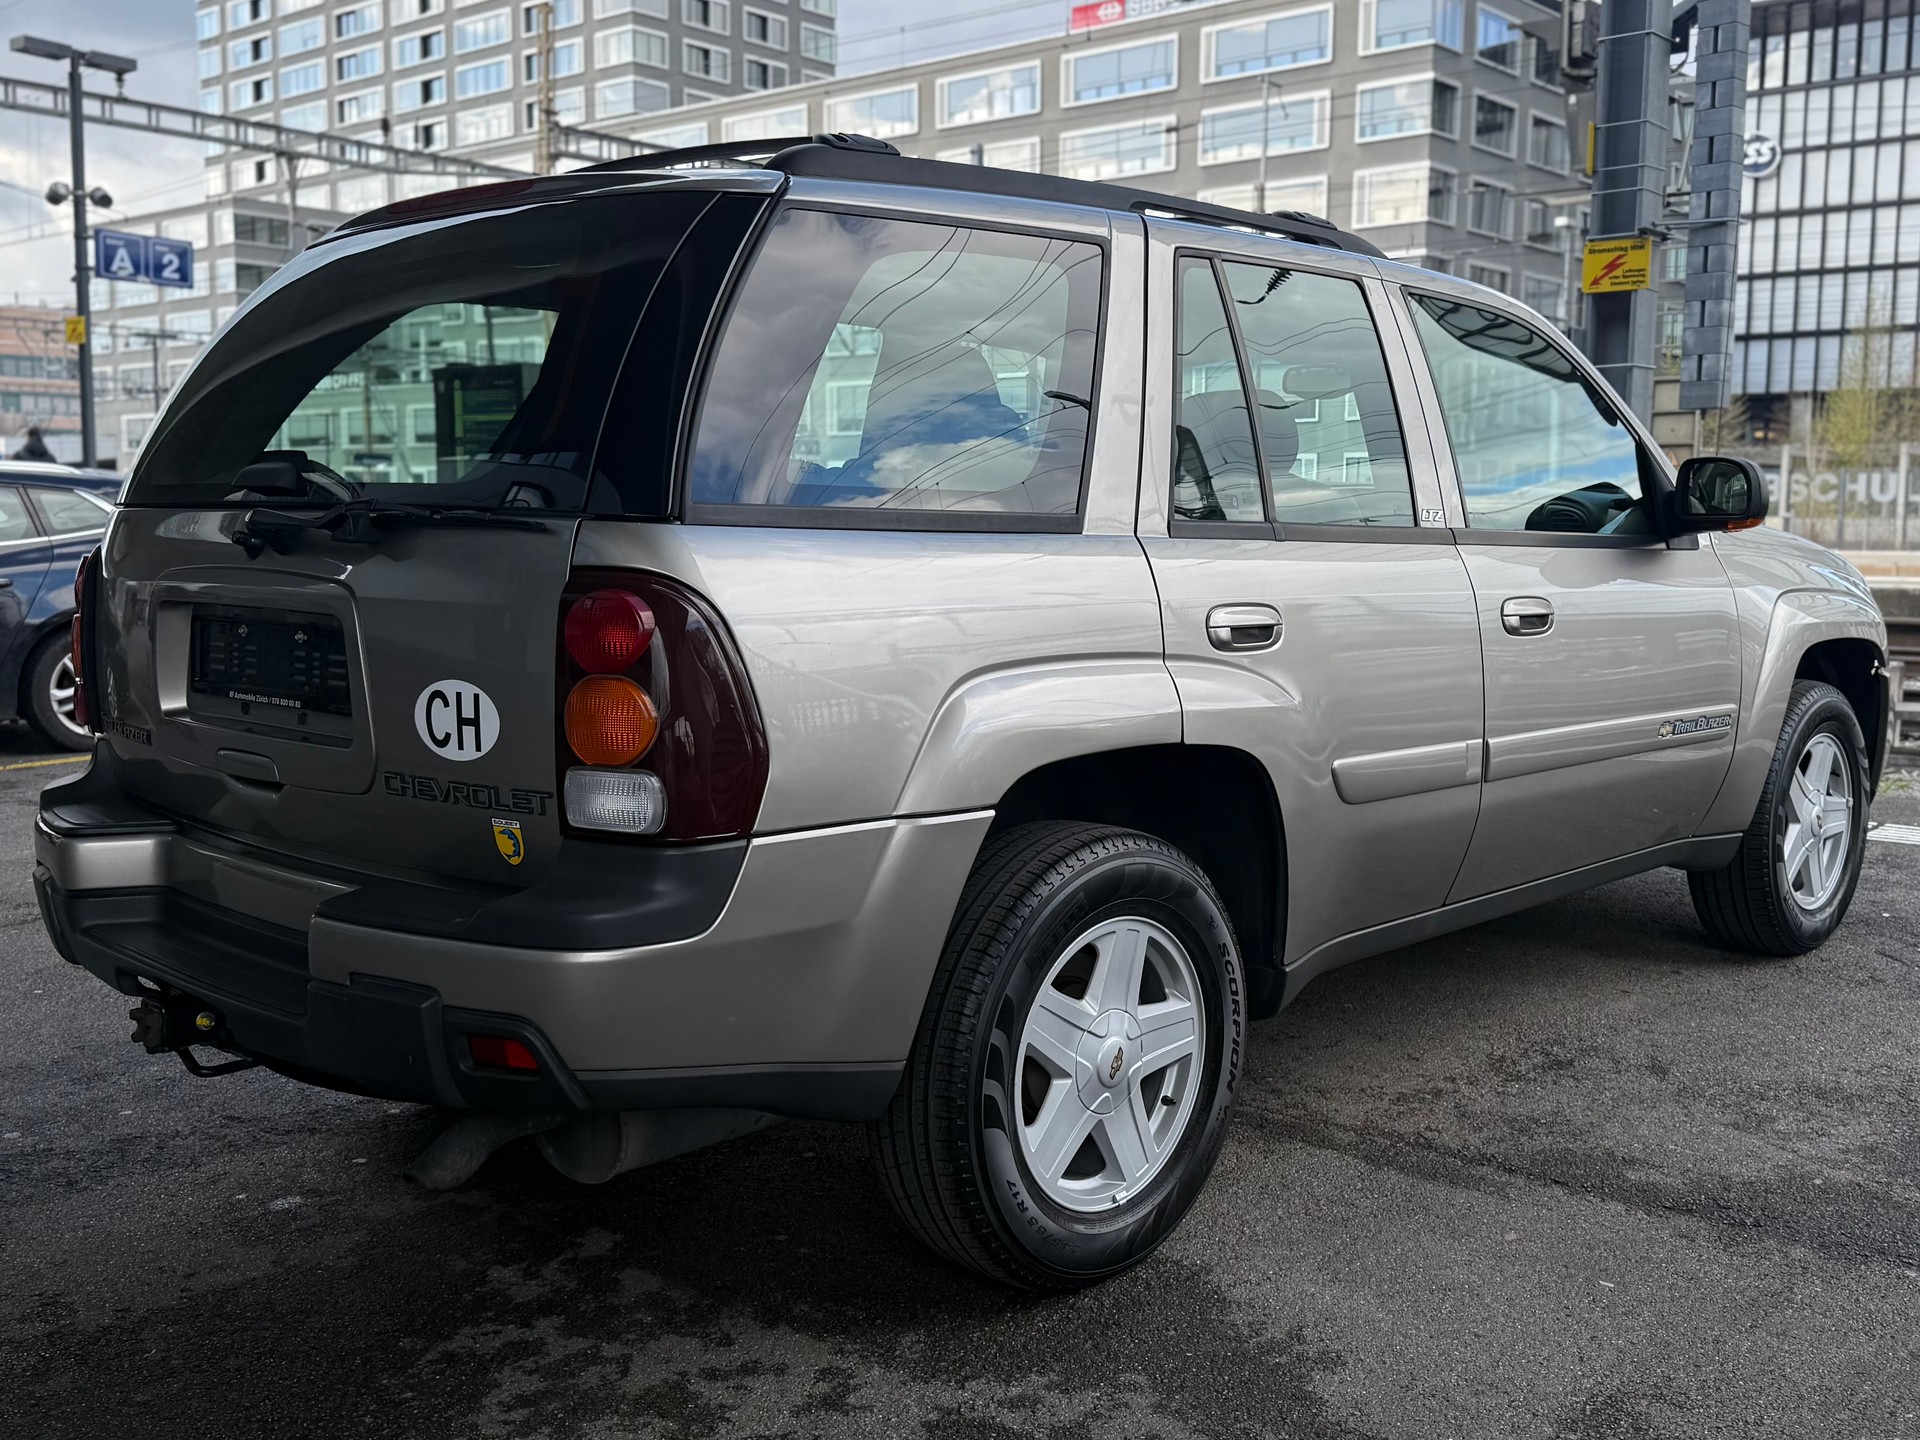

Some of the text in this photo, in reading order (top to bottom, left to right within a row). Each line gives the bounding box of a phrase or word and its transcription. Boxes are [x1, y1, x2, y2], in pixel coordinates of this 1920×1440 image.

[110, 247, 180, 280] A 2
[1588, 246, 1629, 255] Stromschlag
[426, 690, 482, 753] CH
[383, 770, 554, 817] CHEVROLET
[1218, 941, 1241, 1095] SCORPION
